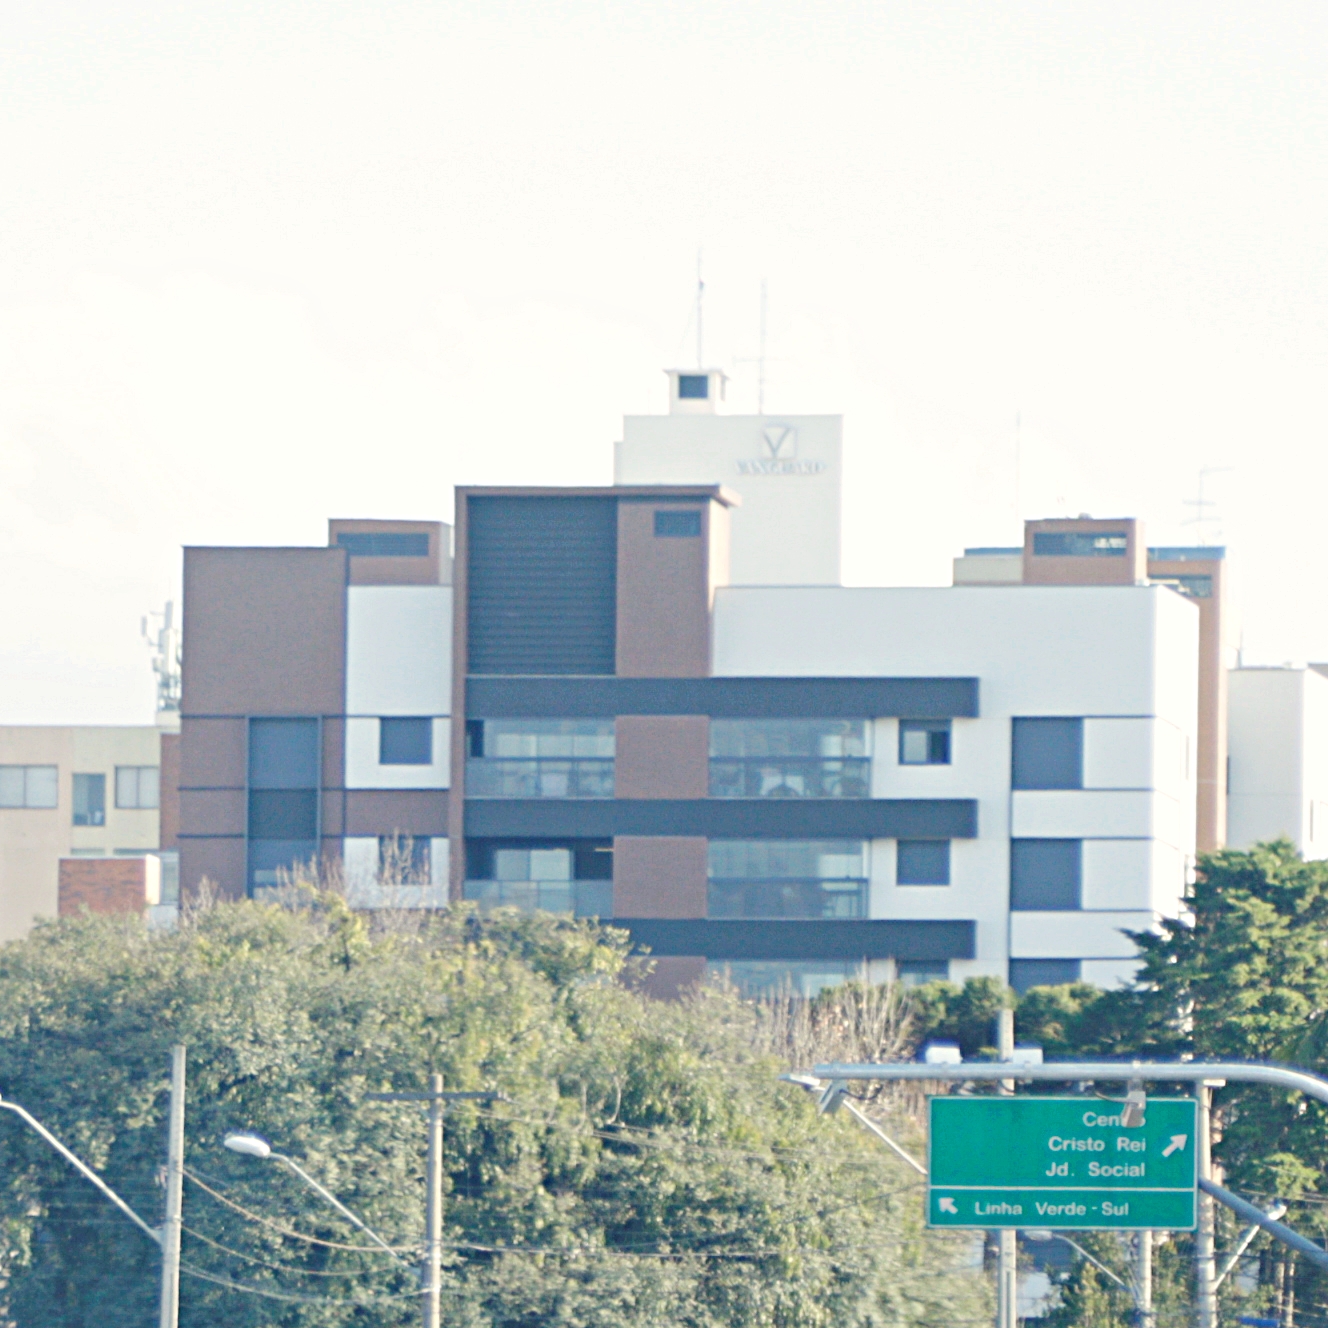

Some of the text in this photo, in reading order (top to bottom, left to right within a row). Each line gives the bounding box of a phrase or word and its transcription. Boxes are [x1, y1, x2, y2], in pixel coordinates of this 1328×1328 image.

[1082, 1111, 1146, 1127] Cen
[1048, 1136, 1146, 1152] Cristo Rei
[1045, 1162, 1146, 1177] Jd. Social
[975, 1201, 1022, 1215] Linha
[1035, 1201, 1086, 1215] Verde
[1102, 1201, 1129, 1216] Sul
